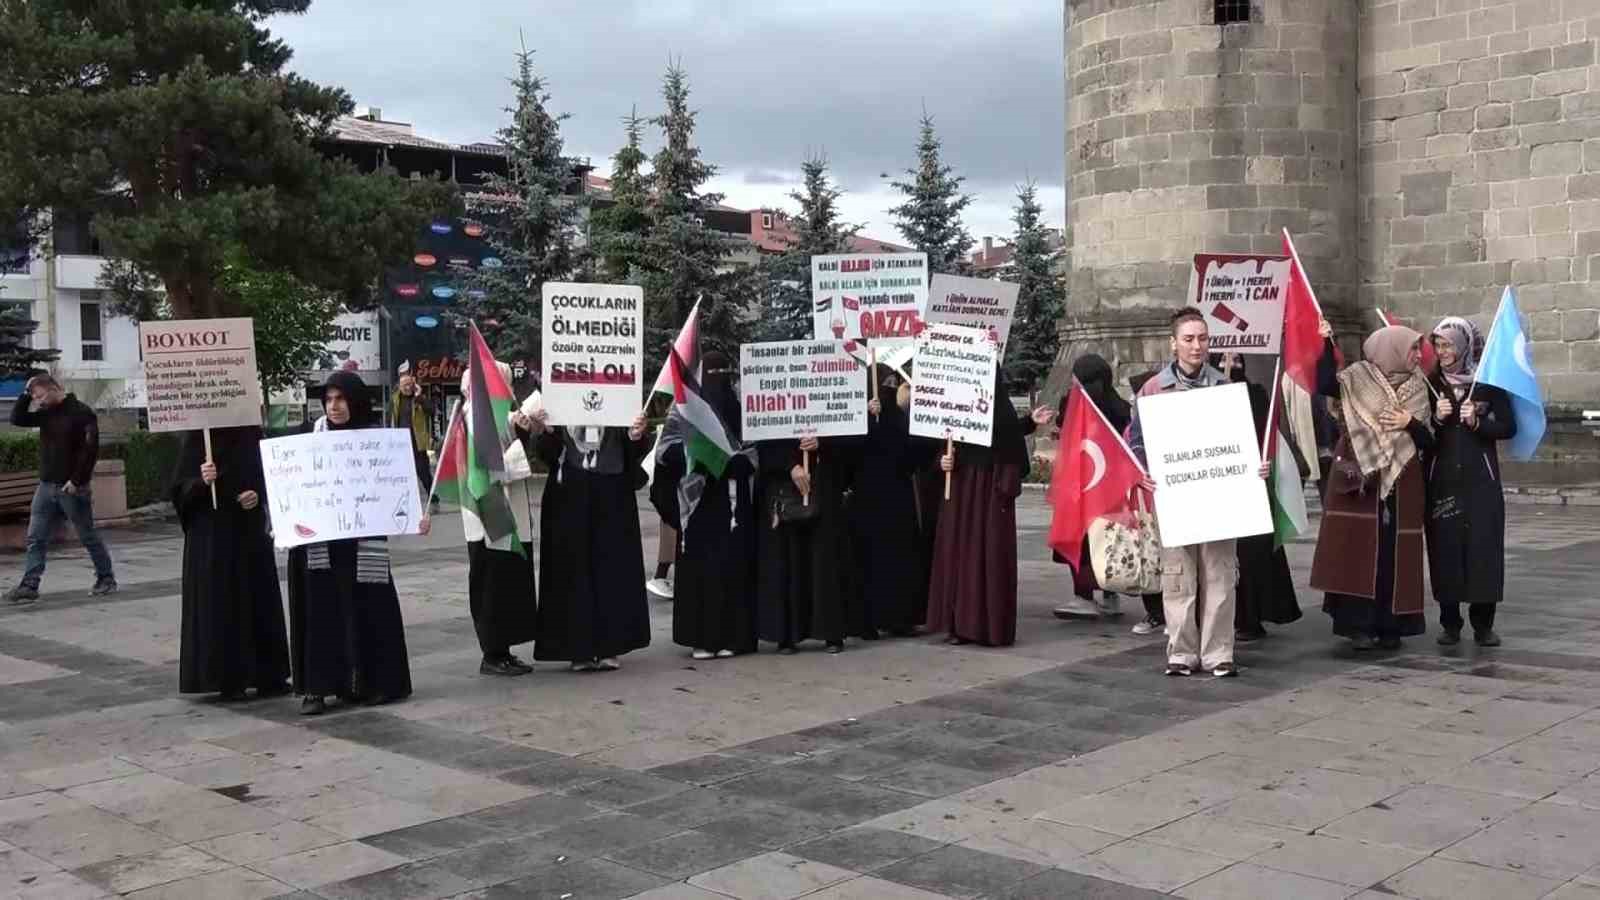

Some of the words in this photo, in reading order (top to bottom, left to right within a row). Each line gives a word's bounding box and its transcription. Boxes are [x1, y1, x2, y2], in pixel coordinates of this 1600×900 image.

[1246, 287, 1251, 301] 1
[1253, 286, 1279, 301] CAN
[551, 295, 636, 311] ÇOCUKLARIN
[551, 314, 636, 338] ÖLMEDİĞİ
[146, 331, 230, 349] BOYKOT
[1208, 334, 1238, 347] YKOTA
[551, 341, 584, 353] ÖZGÜR
[586, 344, 635, 355] GAZZE'NİN
[792, 344, 804, 356] bir
[551, 357, 596, 382] SESİ
[811, 359, 859, 373] Zulmüne
[759, 378, 787, 390] Engel
[746, 393, 806, 413] Allah'ın
[914, 413, 939, 425] UYAN
[1165, 469, 1208, 487] ÇOCUKLAR
